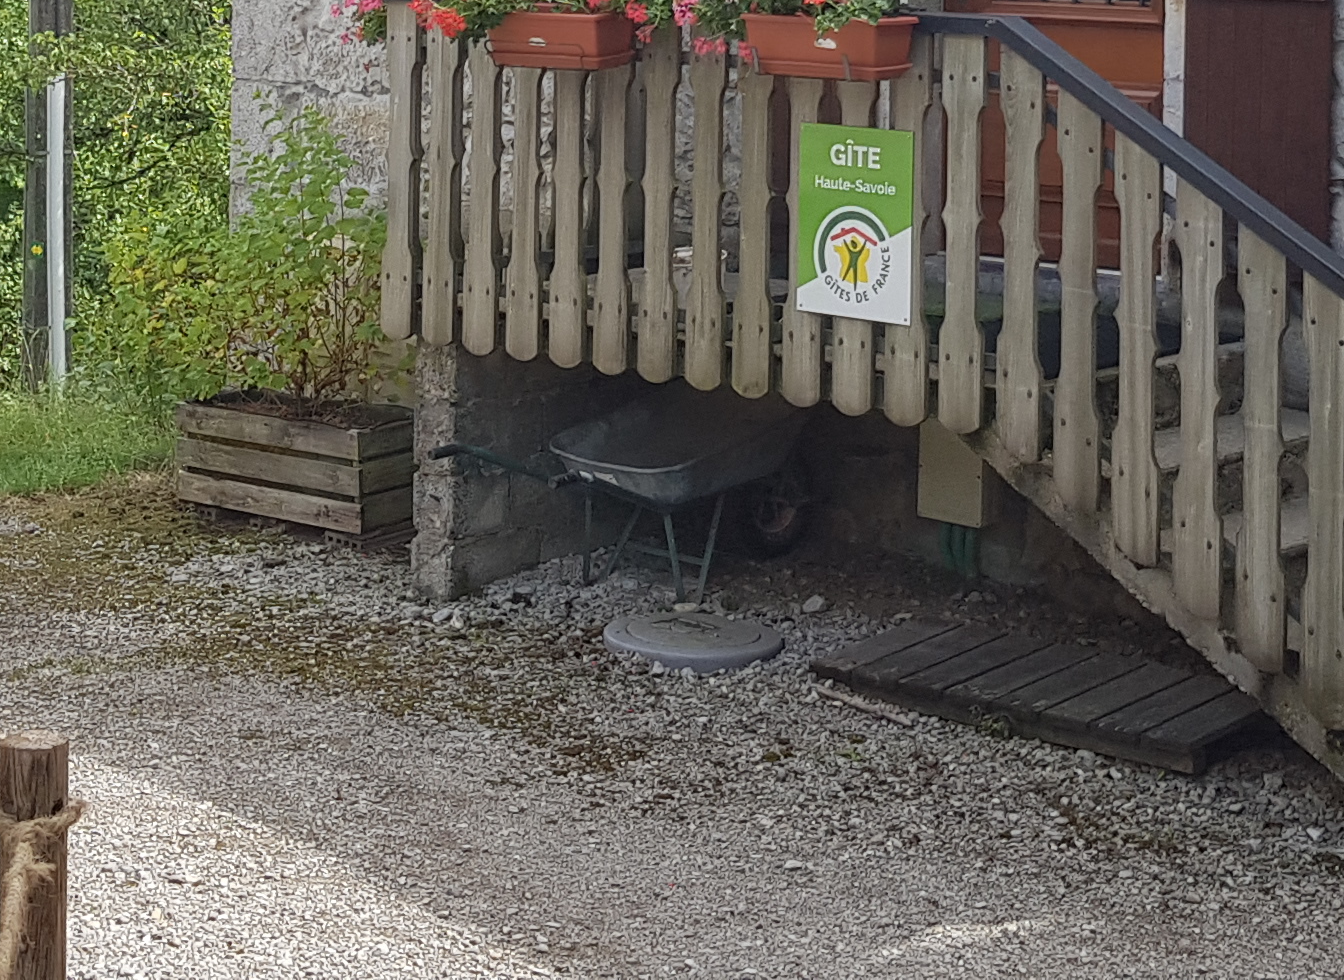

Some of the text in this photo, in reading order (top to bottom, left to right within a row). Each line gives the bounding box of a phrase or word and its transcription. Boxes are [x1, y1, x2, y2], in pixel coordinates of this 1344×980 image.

[830, 139, 881, 169] GÎTE
[815, 175, 896, 196] Haute-Savoie
[825, 246, 891, 303] GÎTES DE FRANCE
